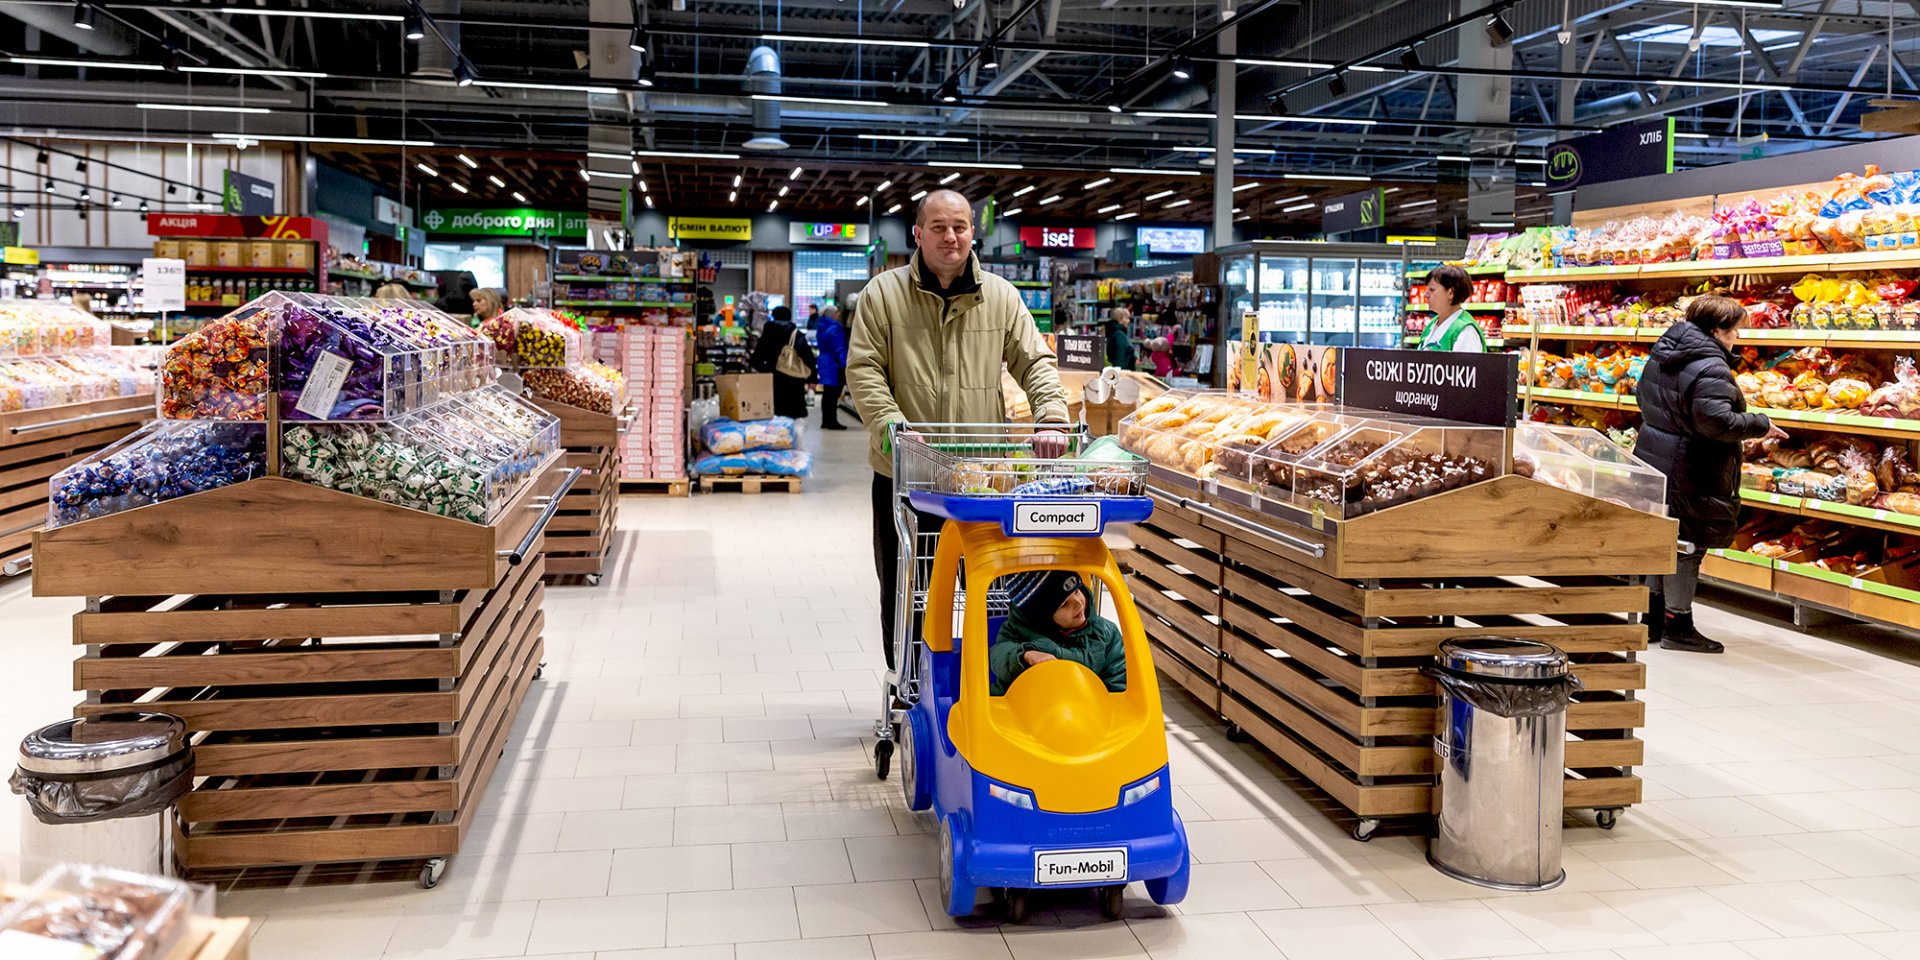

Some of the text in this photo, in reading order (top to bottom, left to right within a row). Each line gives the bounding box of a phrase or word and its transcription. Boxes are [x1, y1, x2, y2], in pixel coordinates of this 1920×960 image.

[1639, 130, 1662, 145] ХЛІБ
[160, 217, 197, 229] АКЦІЯ
[452, 209, 522, 230] доброго
[524, 216, 555, 230] дня
[671, 223, 749, 234] ОБМІН ВАЛЮТ
[804, 223, 857, 238] YUPPIE
[1042, 227, 1075, 247] isei
[1366, 360, 1476, 388] СВІЖІ БУЛОЧКИ
[1395, 390, 1439, 411] щоранку
[1030, 511, 1085, 525] Compact
[1049, 860, 1114, 875] Fun-Mobil
